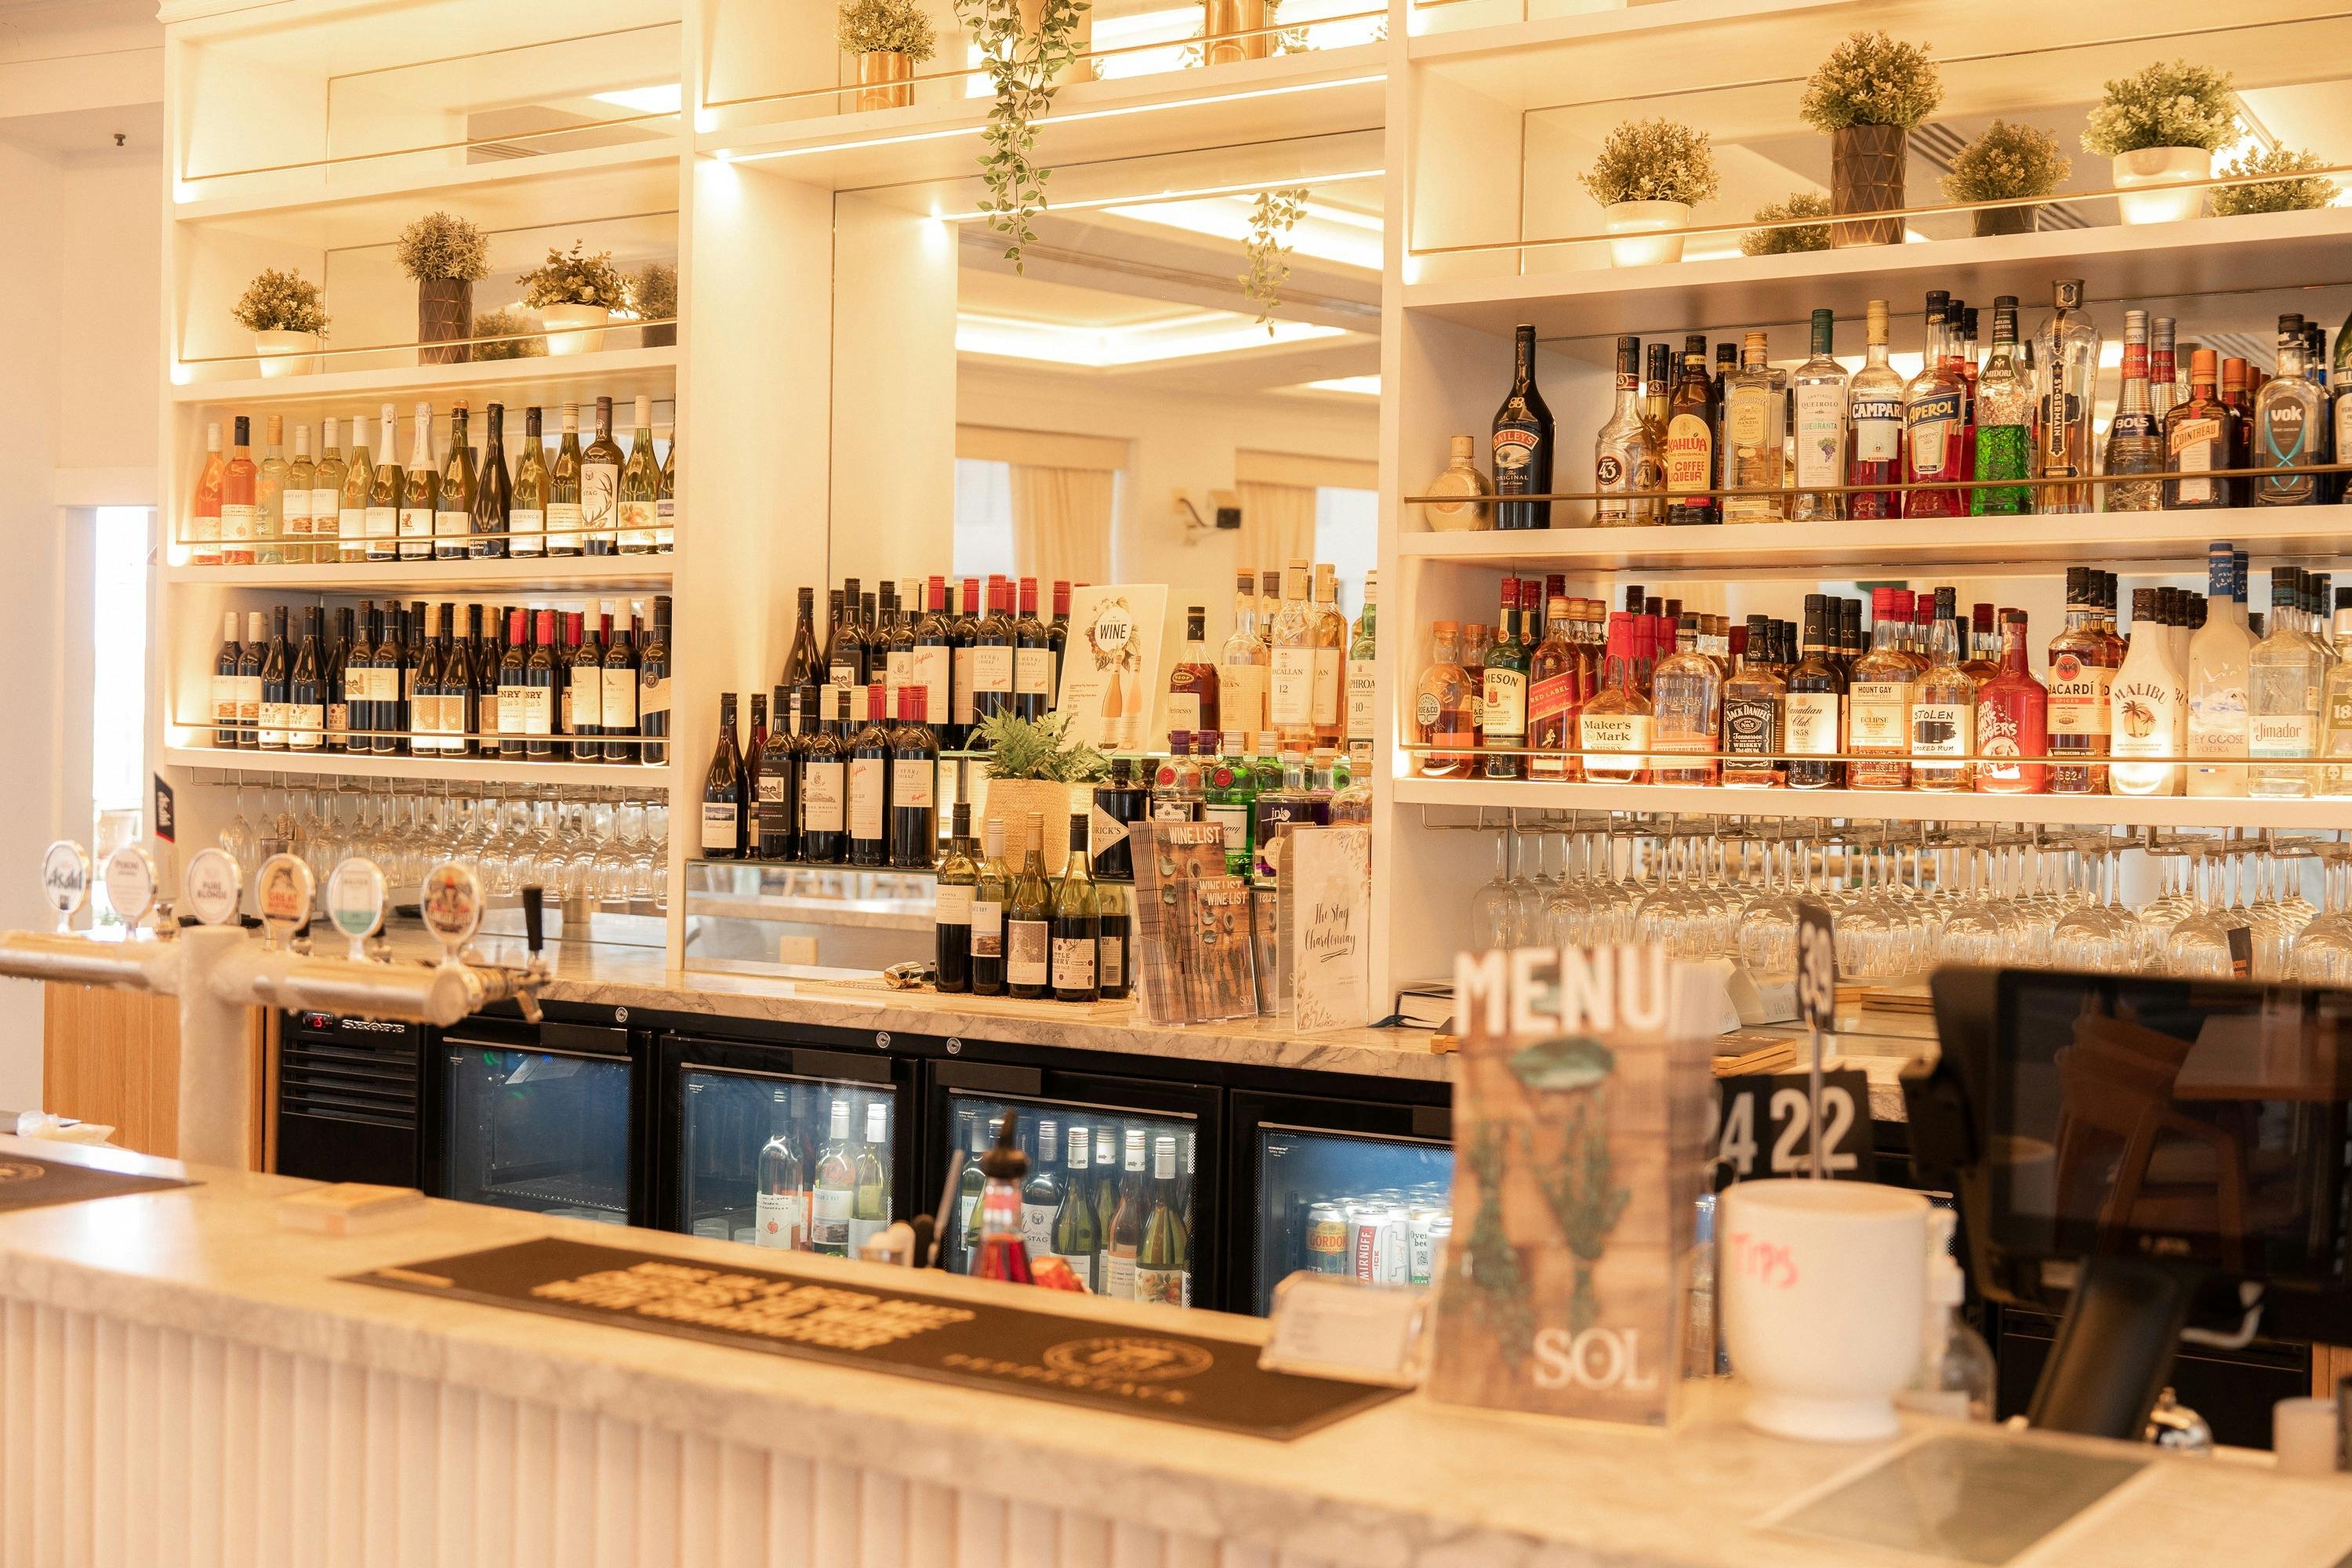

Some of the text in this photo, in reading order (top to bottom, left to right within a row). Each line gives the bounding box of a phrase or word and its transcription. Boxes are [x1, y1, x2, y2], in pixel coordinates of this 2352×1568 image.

[1852, 401, 1903, 418] CAMPARI
[1908, 400, 1954, 423] APEROL
[2270, 405, 2303, 422] vok
[2115, 417, 2150, 429] BOLS
[1494, 431, 1534, 447] BAILEYS
[1668, 433, 1708, 452] KAHLÚA
[2173, 423, 2216, 449] COINTREAU
[1598, 461, 1617, 480] 43
[1675, 461, 1704, 471] COFFEE
[1668, 471, 1703, 483] LIQUEUR
[1099, 623, 1127, 640] WINE
[525, 691, 543, 699] NRY
[1279, 684, 1289, 693] 12
[1530, 694, 1544, 704] RED
[1546, 684, 1570, 698] LABEL
[1878, 686, 1893, 695] GAY
[2048, 681, 2093, 695] BACARDÍ
[2114, 683, 2168, 706] MALIBU
[1355, 702, 1364, 712] 10
[1726, 704, 1772, 721] JACK DANIEL'S
[1787, 702, 1824, 715] Canadian
[1914, 710, 1954, 720] STOLEN
[1584, 720, 1632, 730] Maker's
[2256, 722, 2302, 742] Jimador
[1596, 731, 1631, 742] Mark
[2188, 734, 2244, 745] REY GOOSE
[1272, 808, 1287, 819] ink
[1093, 826, 1121, 836] DRICK'S
[1168, 826, 1221, 844] WINE LIST
[47, 867, 83, 891] Asahi
[202, 881, 223, 891] PURE
[198, 891, 227, 900] BLONDE
[268, 891, 298, 903] GREAT
[1207, 891, 1247, 906] WINE LIST
[1315, 902, 1350, 931] The Stag
[1305, 928, 1357, 956] Chardonnay
[1455, 941, 1665, 1038] MENU
[1239, 995, 1254, 1007] SOL
[1769, 1087, 1859, 1173] 22
[1533, 1327, 1659, 1391] SOL
